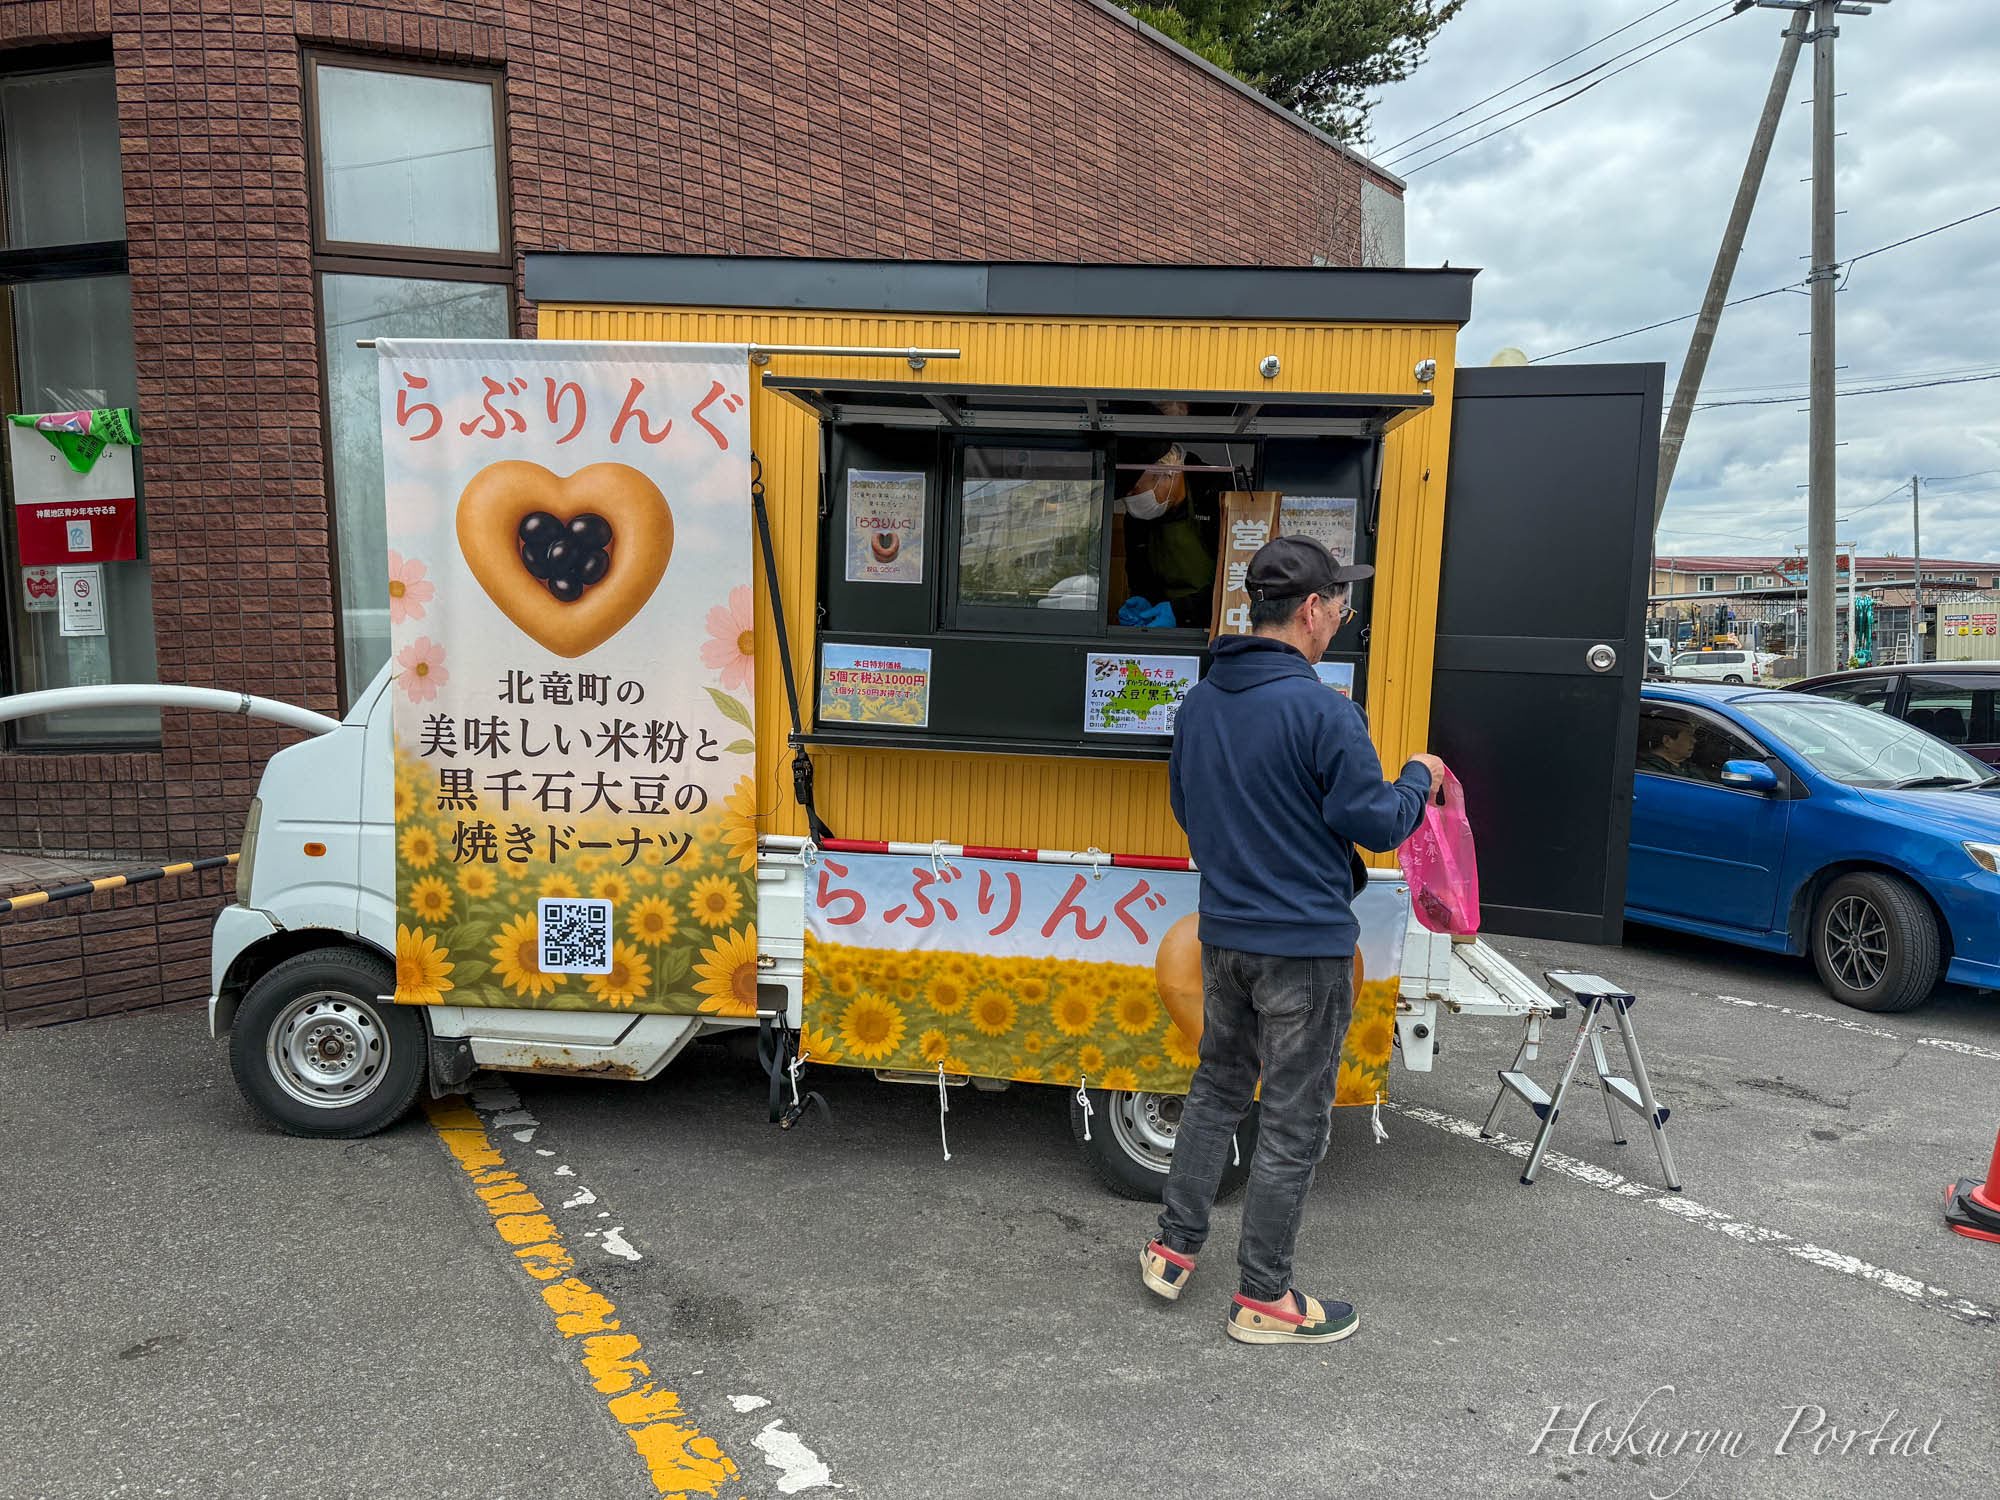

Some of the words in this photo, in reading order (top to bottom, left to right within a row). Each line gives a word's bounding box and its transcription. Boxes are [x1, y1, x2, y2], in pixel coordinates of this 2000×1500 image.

[396, 371, 744, 450] らぶりんぐ
[829, 671, 925, 687] 5個で税込1000円
[854, 660, 902, 670] 本日特別価格
[1119, 667, 1175, 678] 黒千石大豆
[498, 669, 645, 707] 北竜町の
[835, 687, 855, 696] 1個分
[420, 713, 720, 764] 美味しい米粉と
[437, 768, 709, 815] 黒千石大豆の
[451, 820, 694, 867] 焼きドーナツ
[816, 858, 1167, 945] らぶりんぐ
